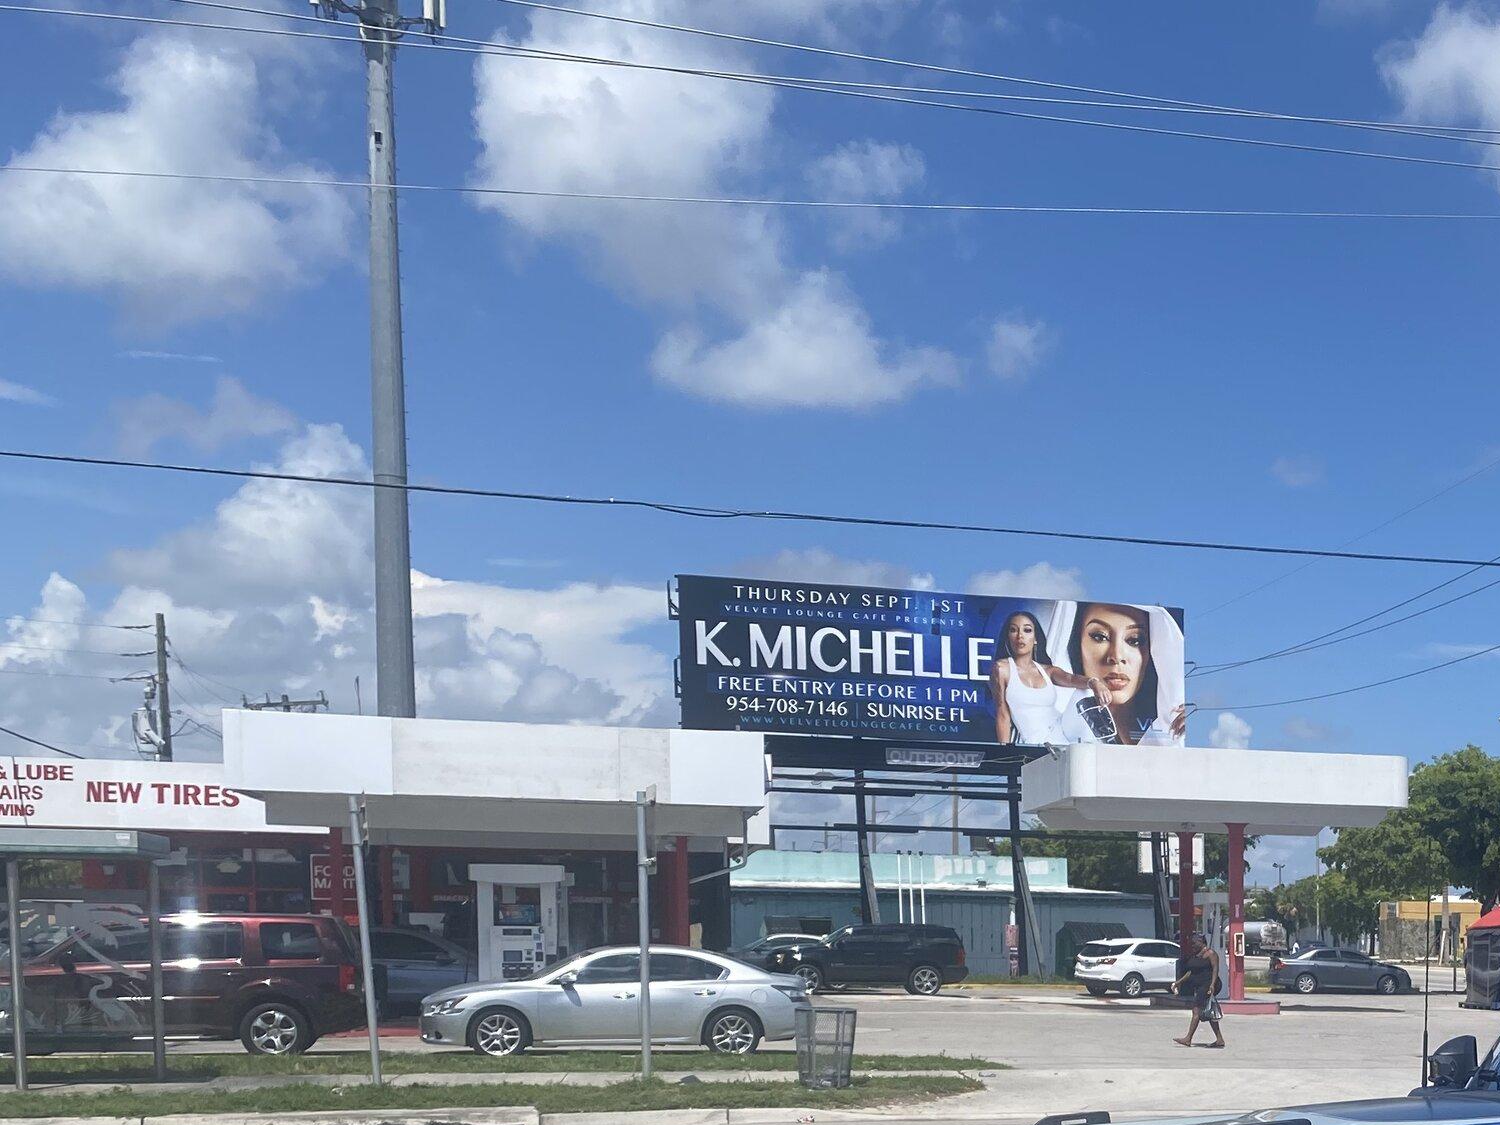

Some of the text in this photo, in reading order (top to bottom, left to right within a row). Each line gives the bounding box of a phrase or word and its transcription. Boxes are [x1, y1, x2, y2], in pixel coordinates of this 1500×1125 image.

[733, 585, 964, 613] THURSDAY SEPT. 1ST
[724, 604, 964, 627] VELVET LOUNGE CAFE PRESENTS
[749, 623, 995, 681] MICHELLE
[718, 676, 978, 703] FREE ENTRY BEFORE 11 PM
[726, 696, 970, 723] 954-708-7146 SUNRISE FL
[13, 764, 74, 781] LUBE
[86, 781, 241, 807] NEW TIRES
[314, 865, 355, 877] FOD
